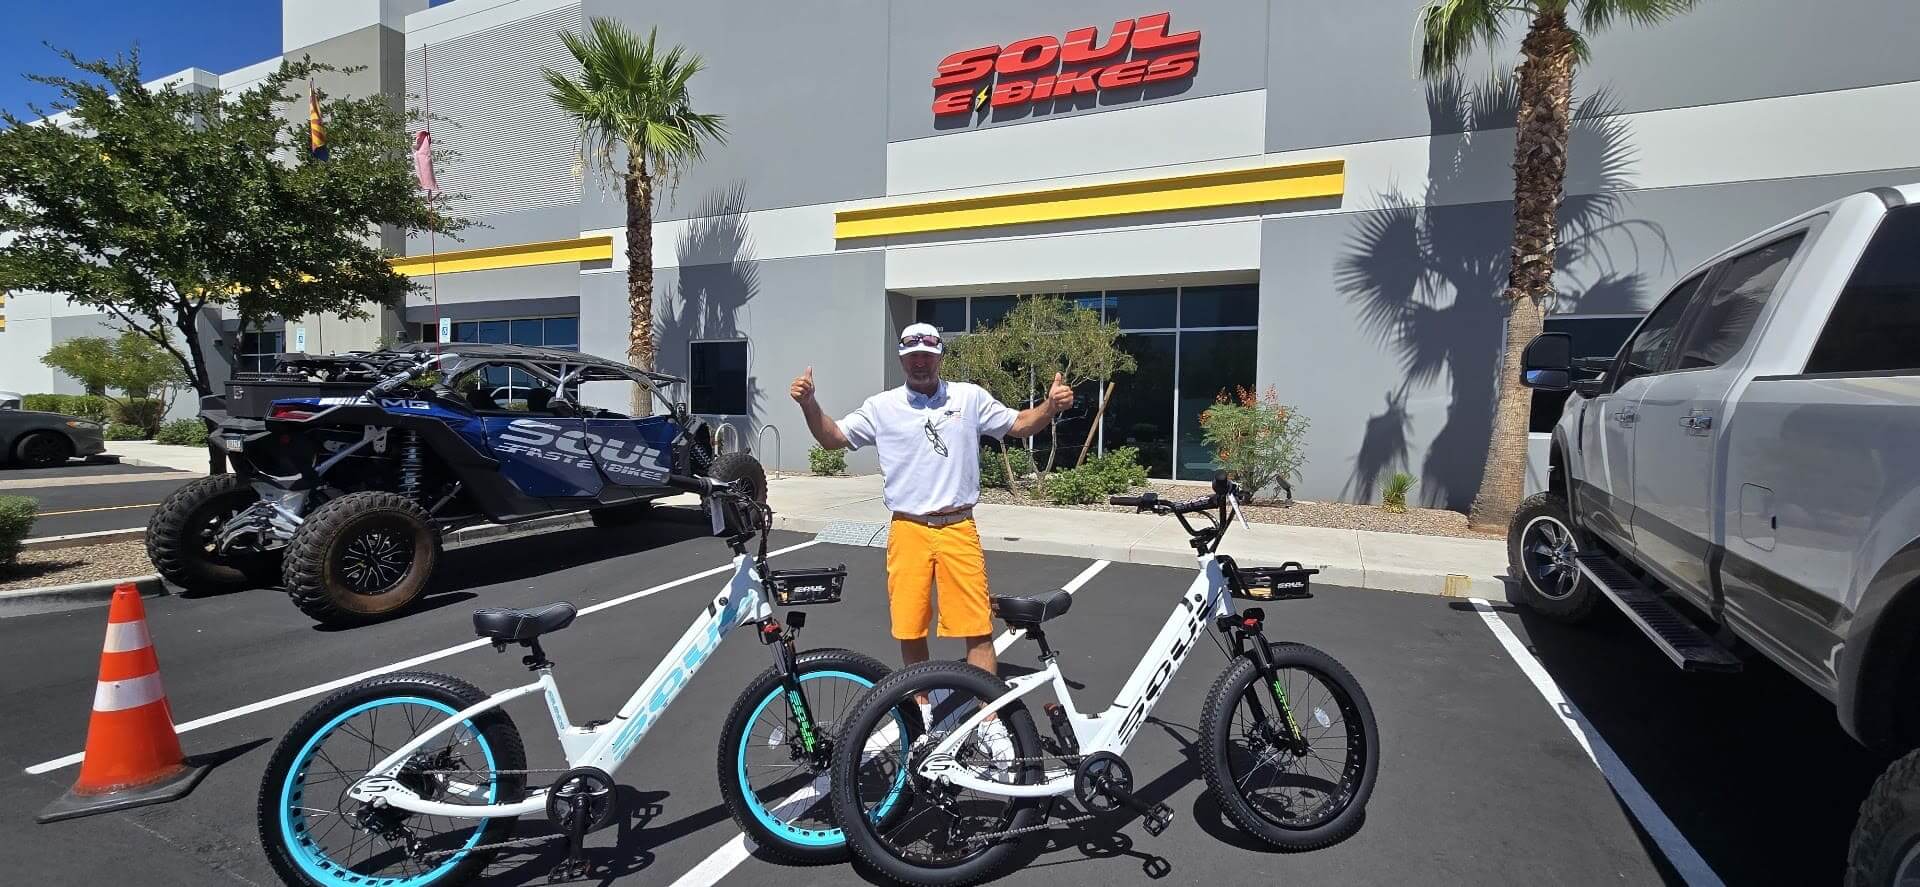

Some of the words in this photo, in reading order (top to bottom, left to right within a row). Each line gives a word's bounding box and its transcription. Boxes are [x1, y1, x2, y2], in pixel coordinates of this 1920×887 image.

[932, 11, 1201, 87] SOUL
[932, 89, 974, 114] E
[991, 51, 1200, 109] BIKES
[499, 419, 670, 473] SOUL
[612, 592, 755, 762] SOUL
[1118, 589, 1223, 746] SOUL
